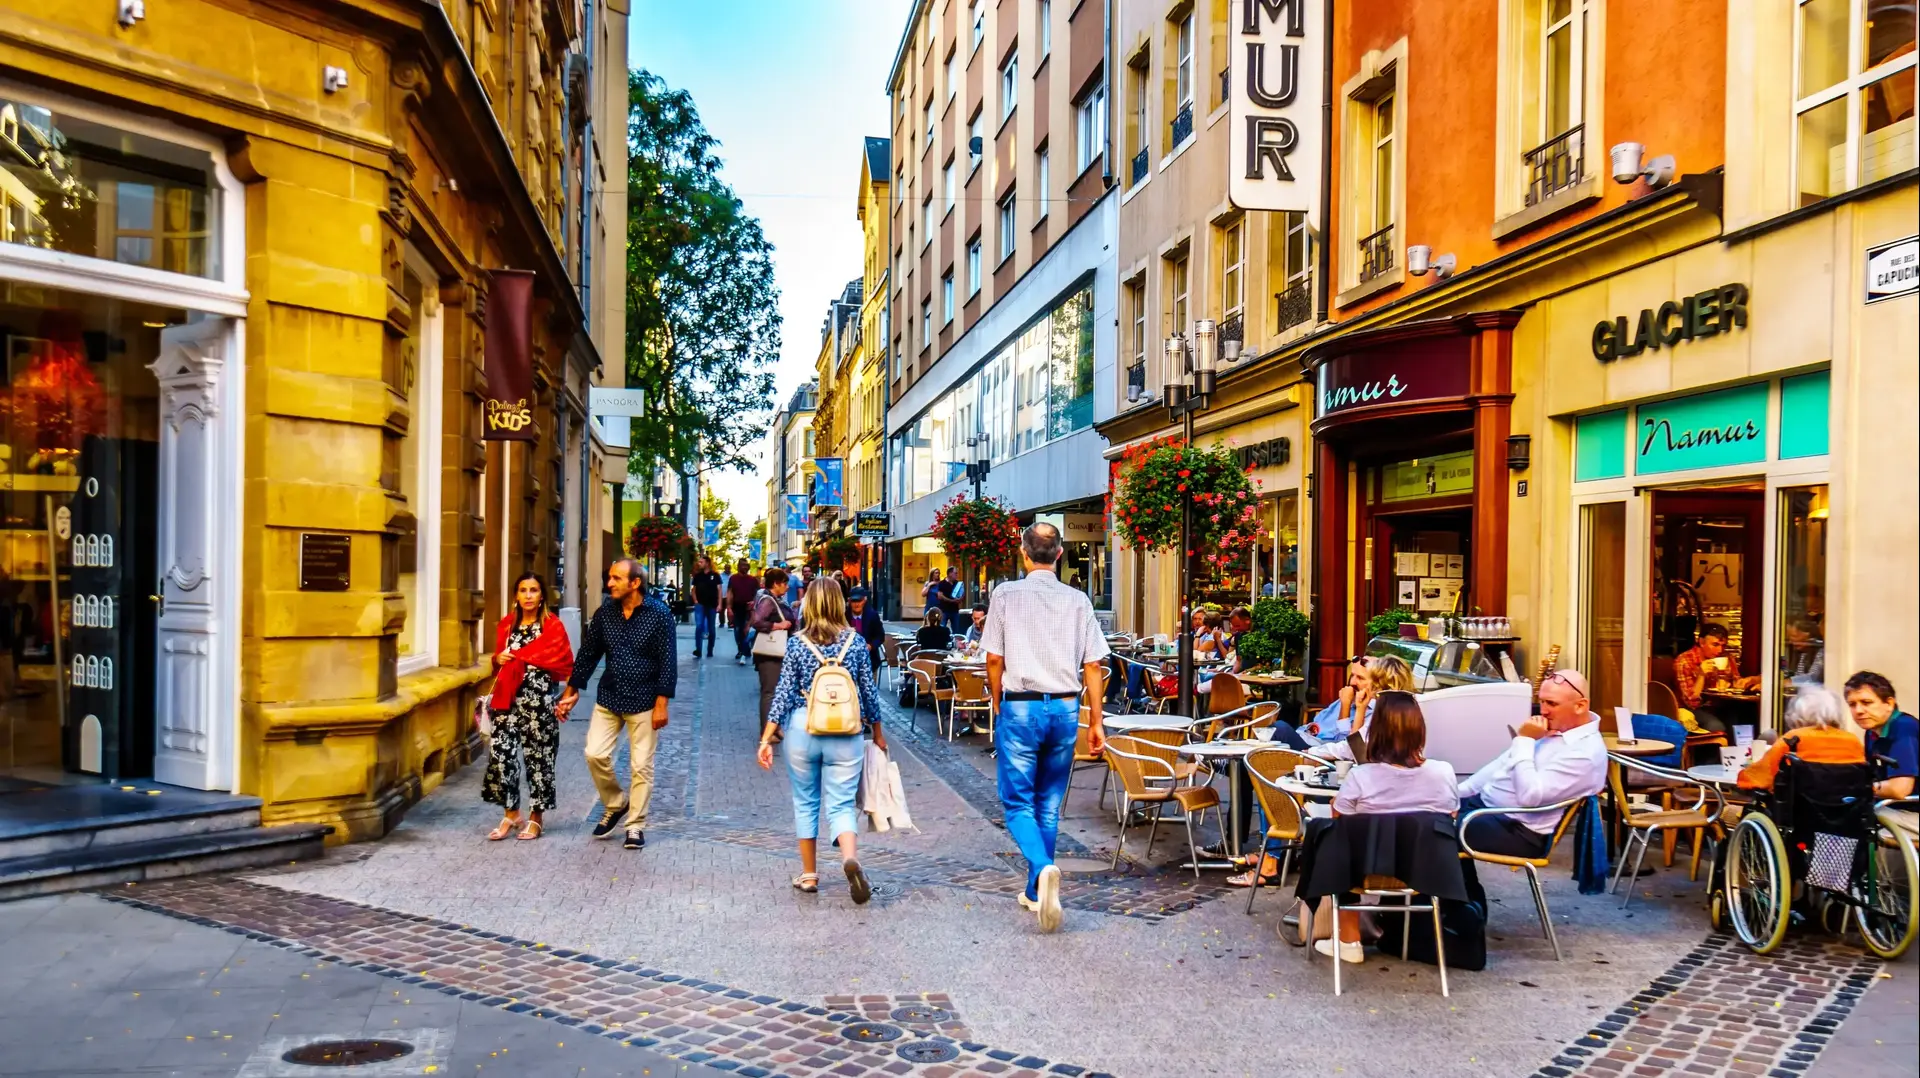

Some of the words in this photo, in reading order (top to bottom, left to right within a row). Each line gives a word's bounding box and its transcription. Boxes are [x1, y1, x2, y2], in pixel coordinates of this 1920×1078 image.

[1890, 258, 1901, 266] RUE
[1904, 253, 1915, 263] DES
[1592, 282, 1749, 362] GLACIER
[596, 398, 639, 406] PANDORA
[488, 409, 531, 431] KIDS
[1641, 418, 1760, 456] Namur
